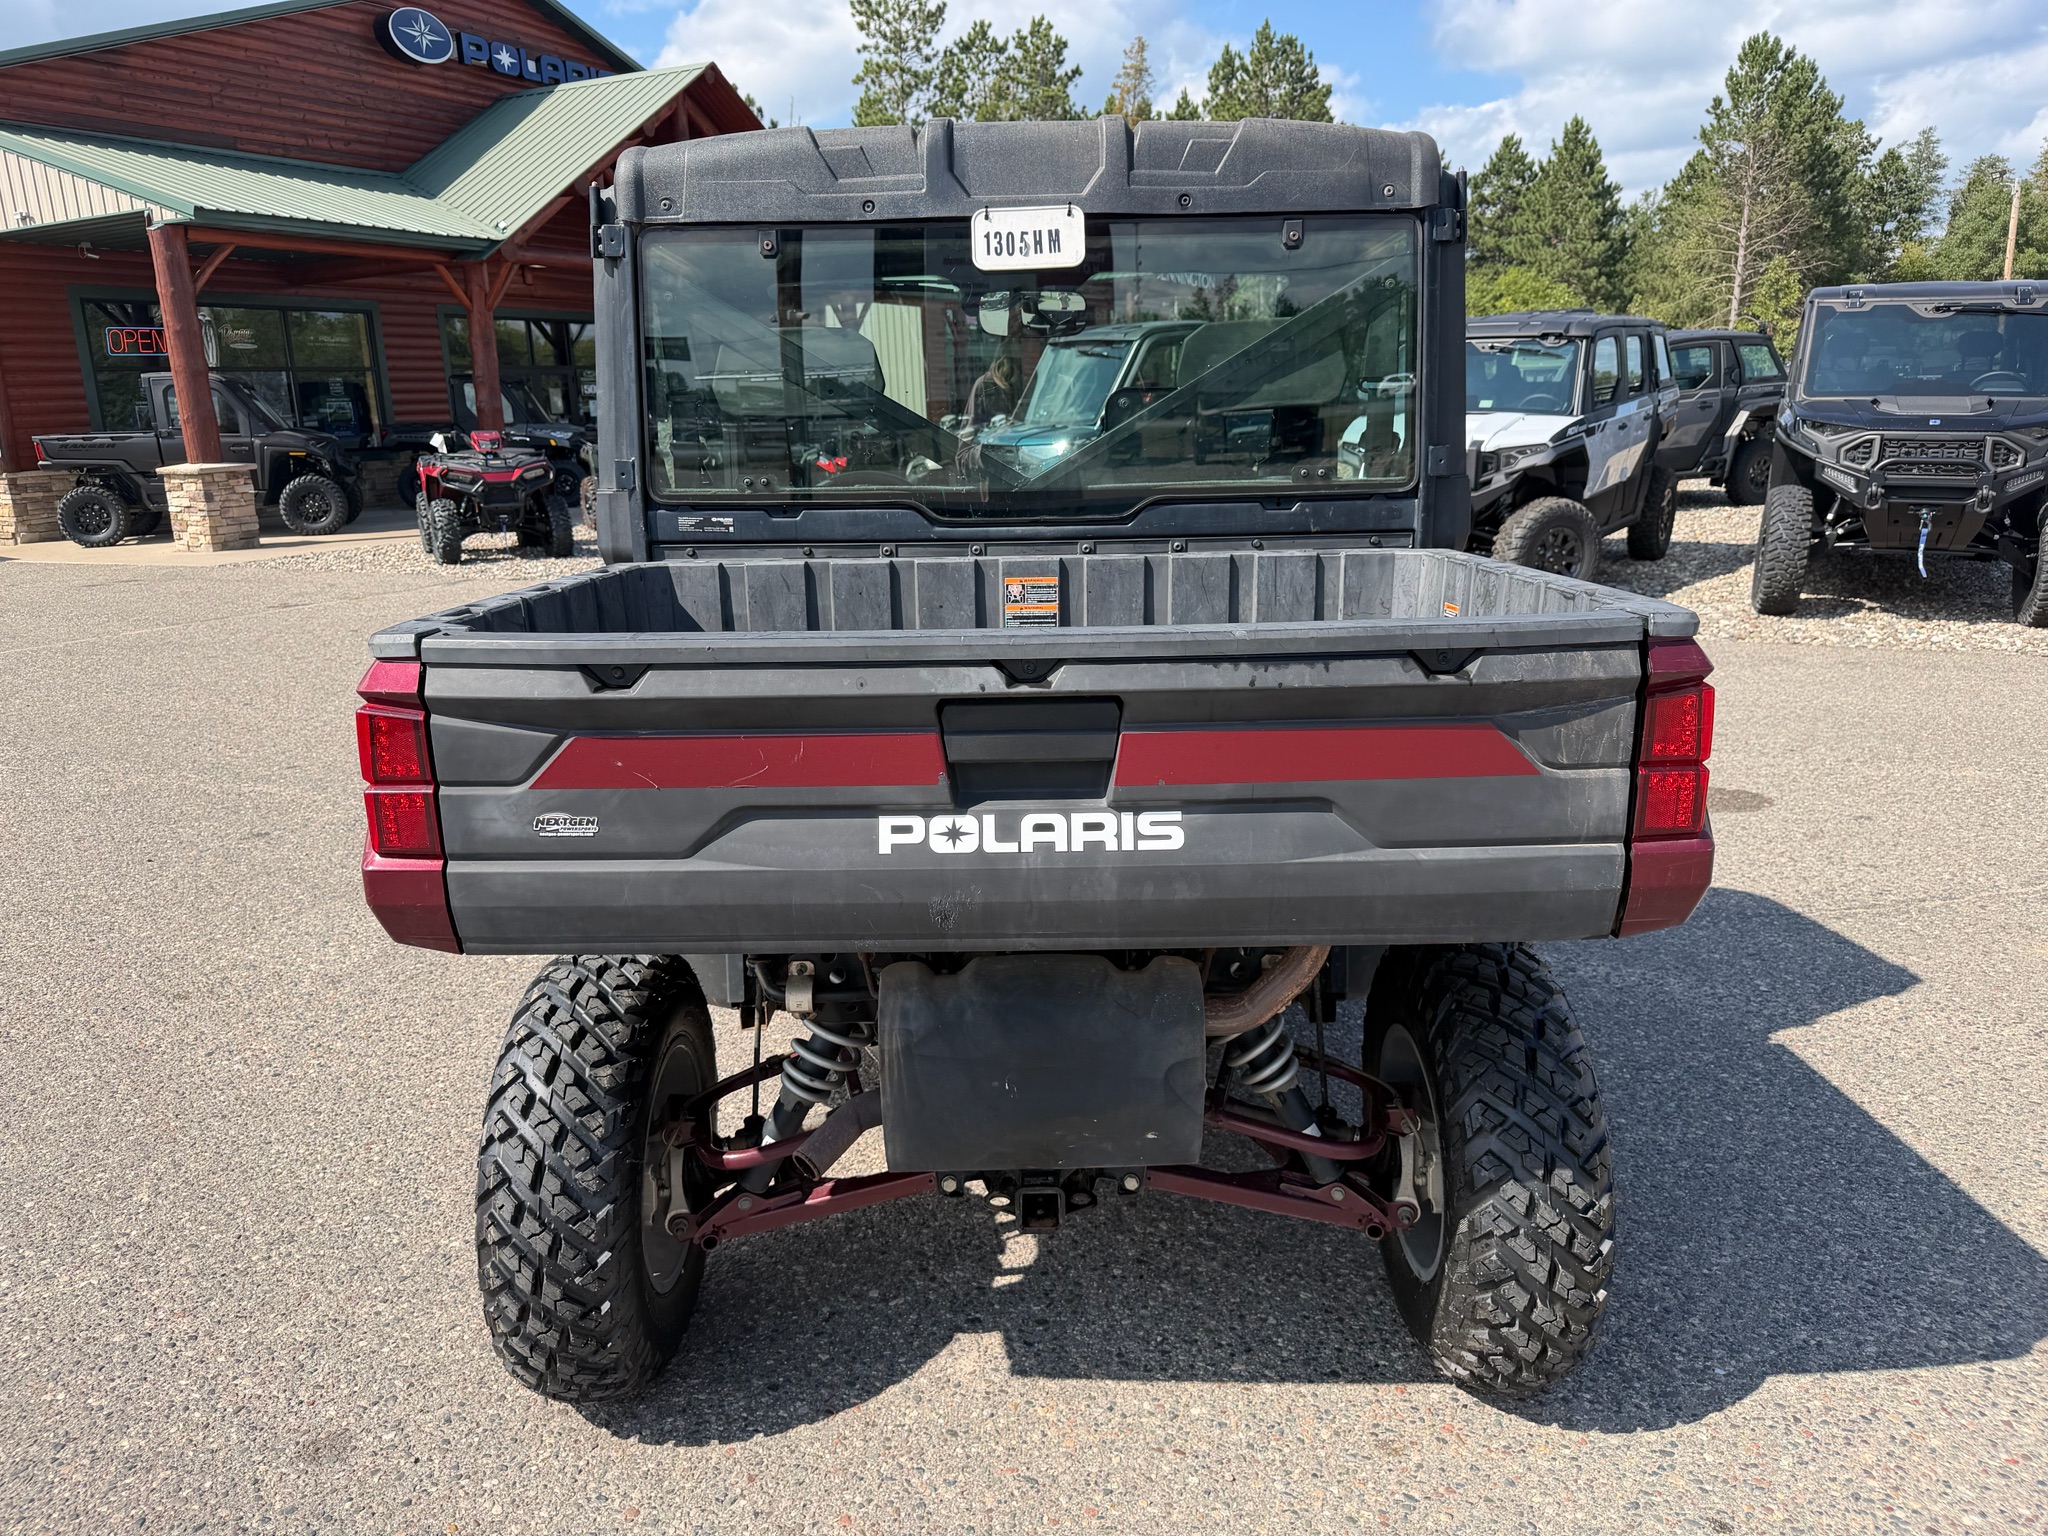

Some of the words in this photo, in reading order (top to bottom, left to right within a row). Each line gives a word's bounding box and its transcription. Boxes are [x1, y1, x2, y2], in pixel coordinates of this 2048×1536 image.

[457, 31, 619, 84] POLAR
[108, 329, 168, 353] OPEN
[1884, 447, 1979, 459] POLARIS
[533, 817, 598, 830] NEXTGEN
[878, 811, 1185, 854] POLARIS
